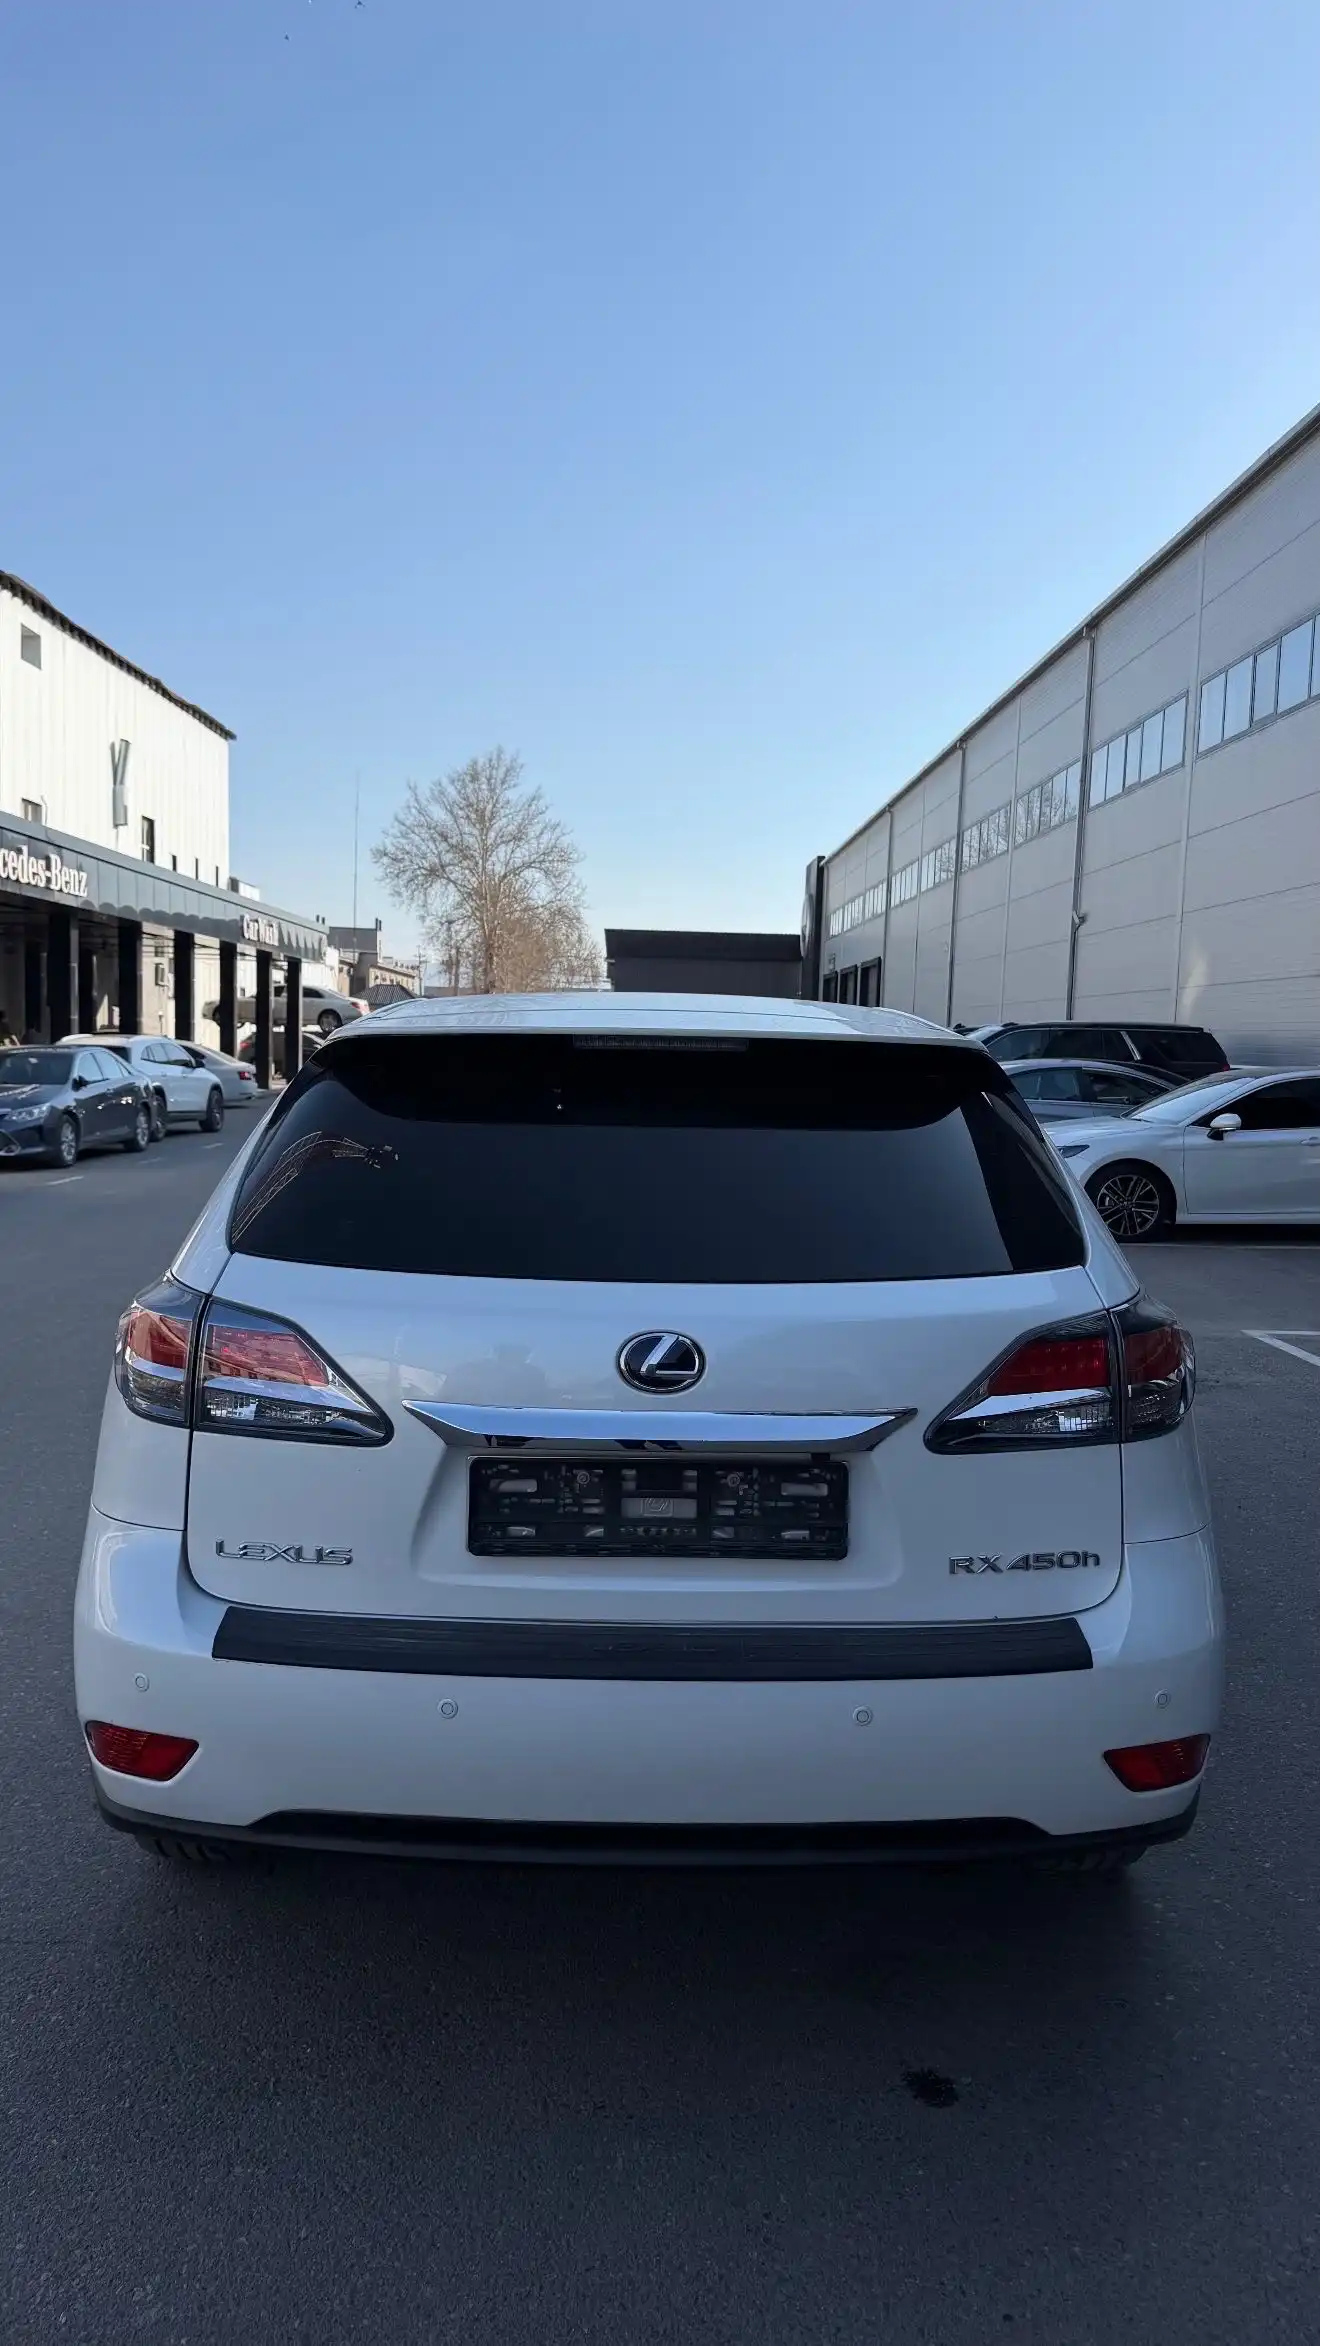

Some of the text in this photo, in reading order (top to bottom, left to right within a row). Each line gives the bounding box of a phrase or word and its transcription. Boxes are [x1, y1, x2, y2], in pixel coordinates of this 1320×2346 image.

[215, 1537, 353, 1565] LEXUS
[949, 1550, 1101, 1574] RX 450h
